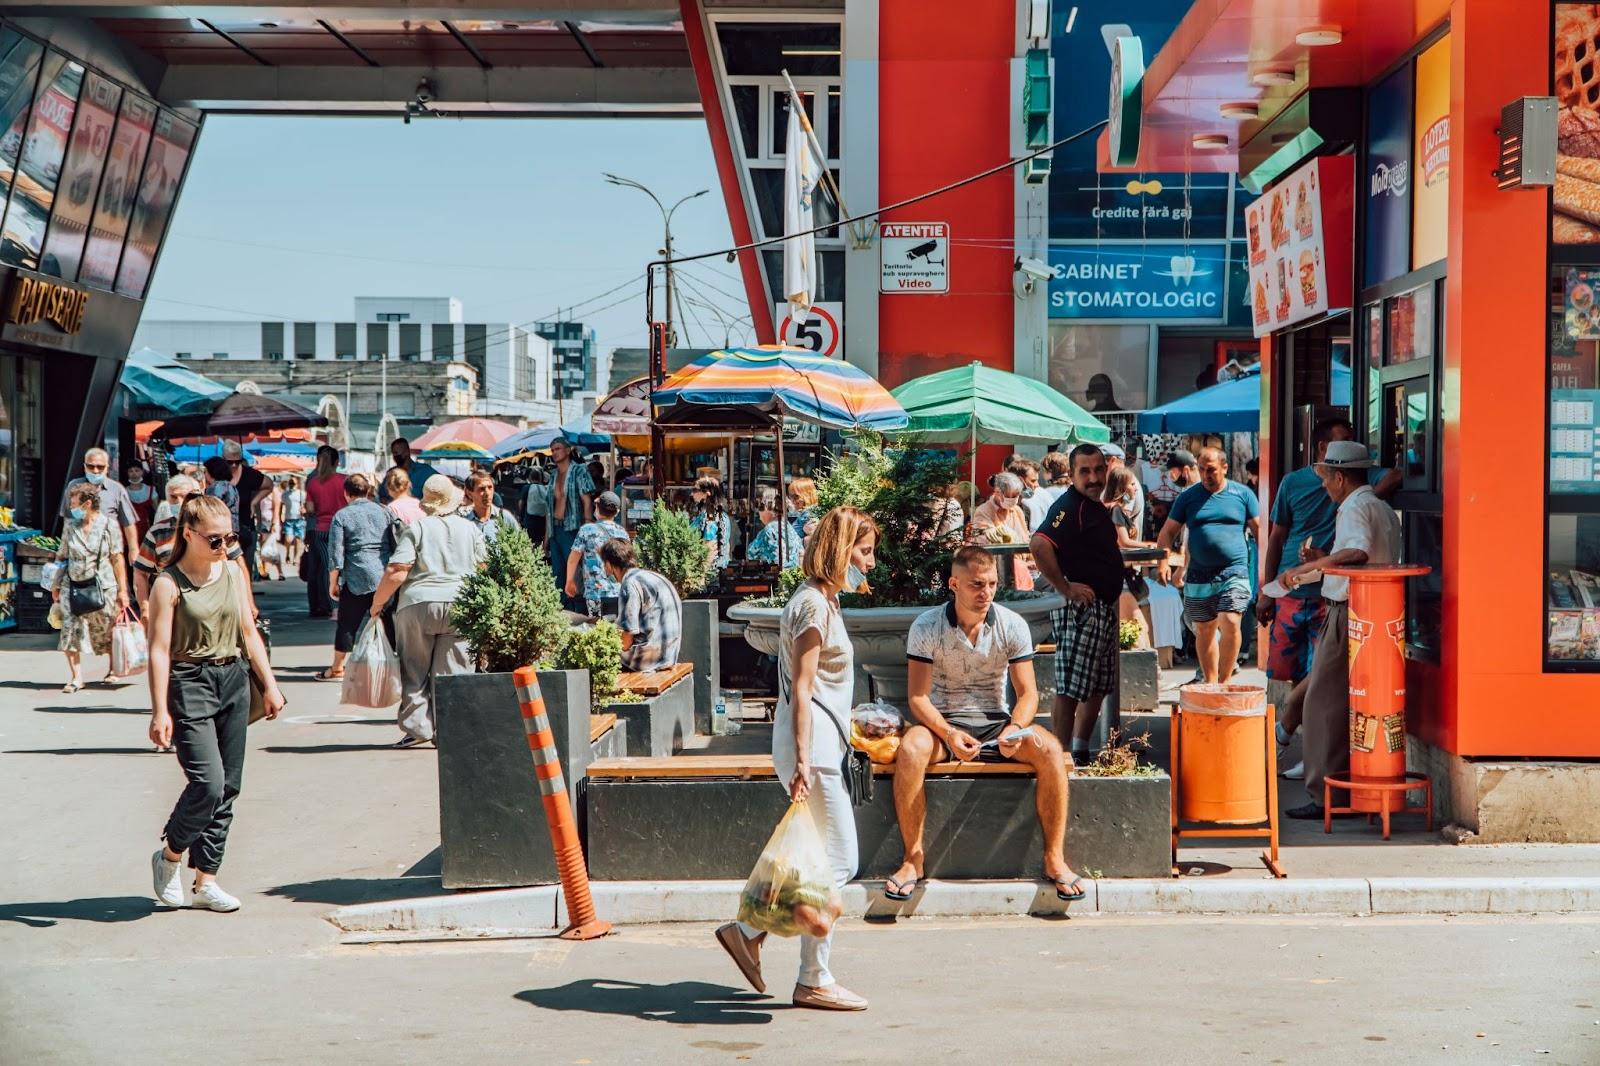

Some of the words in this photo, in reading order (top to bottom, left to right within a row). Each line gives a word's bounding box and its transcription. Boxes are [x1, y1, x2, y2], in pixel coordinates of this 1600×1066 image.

[1092, 207, 1139, 218] Credite
[1141, 206, 1169, 218] fără
[1172, 206, 1192, 220] gaj
[1054, 263, 1142, 279] CABINET
[898, 279, 932, 288] Video
[16, 277, 89, 336] PATISERIE
[1052, 291, 1216, 307] STOMATOLOGIC
[796, 319, 822, 351] 5
